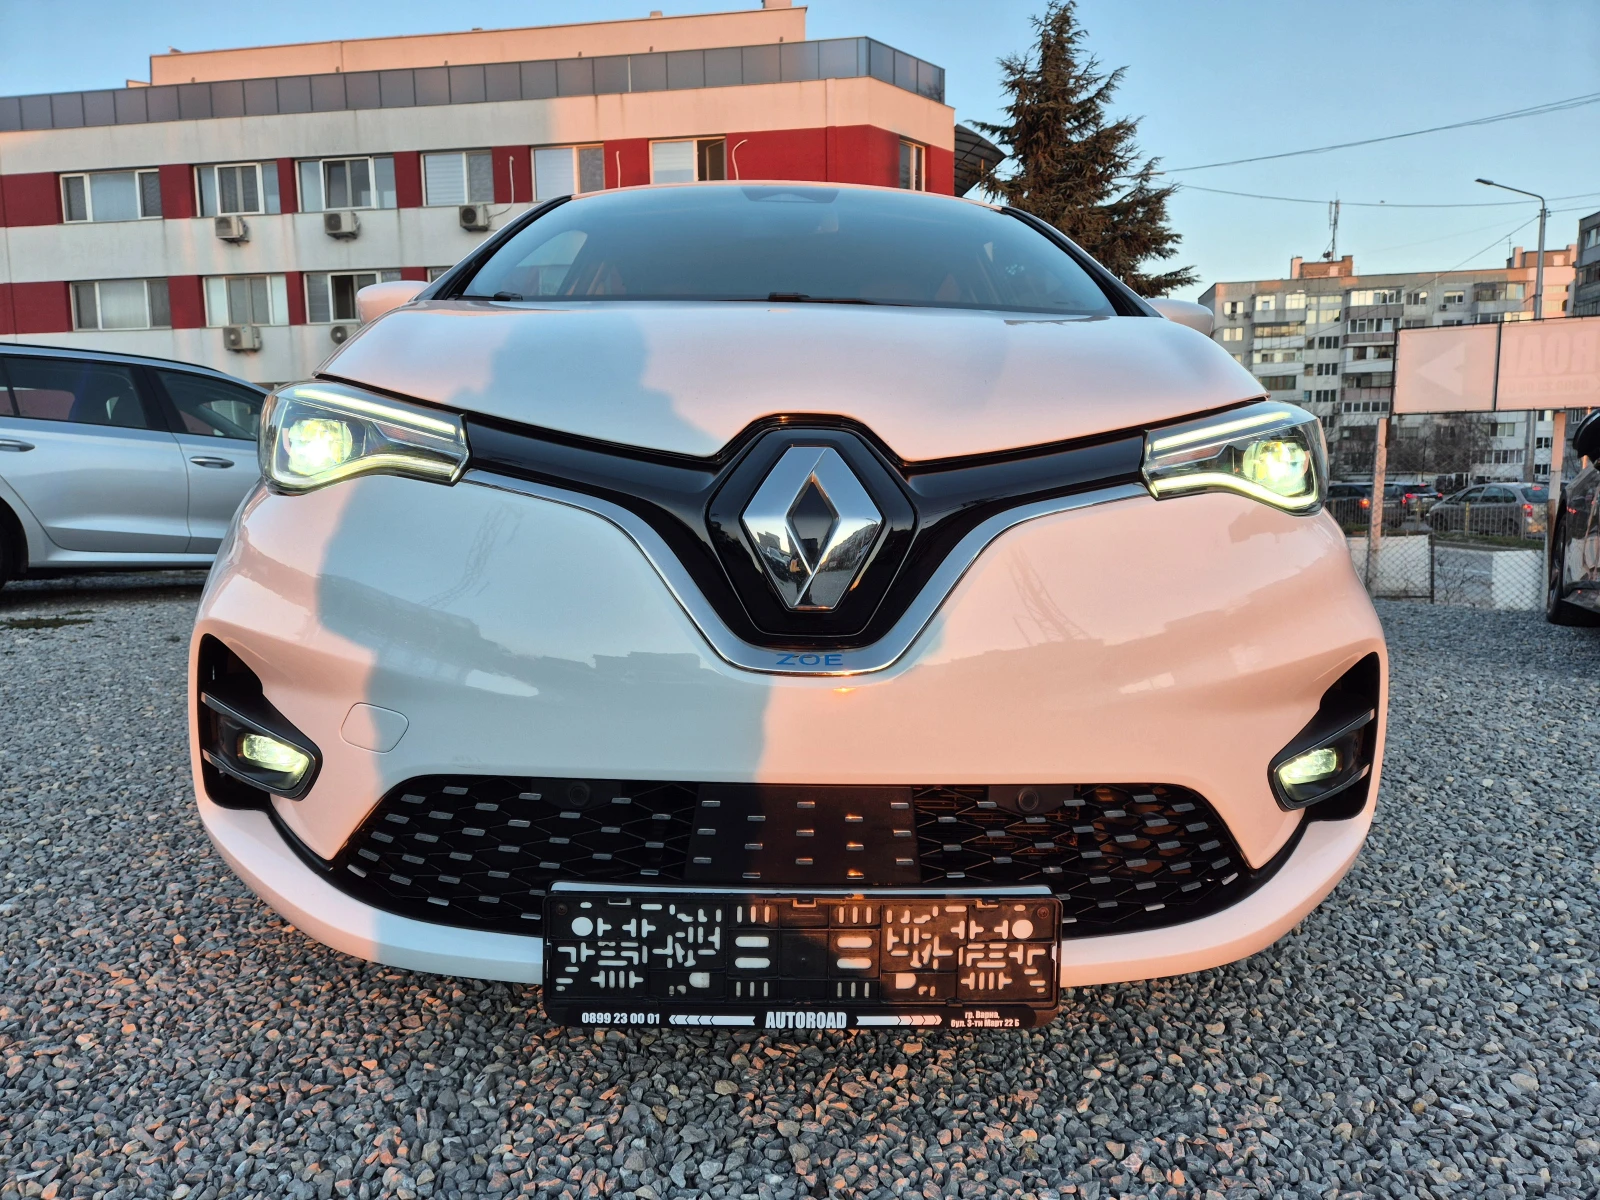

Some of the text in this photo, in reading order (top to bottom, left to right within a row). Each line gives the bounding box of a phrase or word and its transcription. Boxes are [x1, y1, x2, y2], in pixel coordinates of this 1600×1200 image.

[776, 653, 843, 666] ZOE
[581, 1012, 660, 1024] 0899 23 00 01
[765, 1011, 847, 1029] AUTOROAD
[983, 1019, 1003, 1028] Март
[1004, 1018, 1014, 1027] 22
